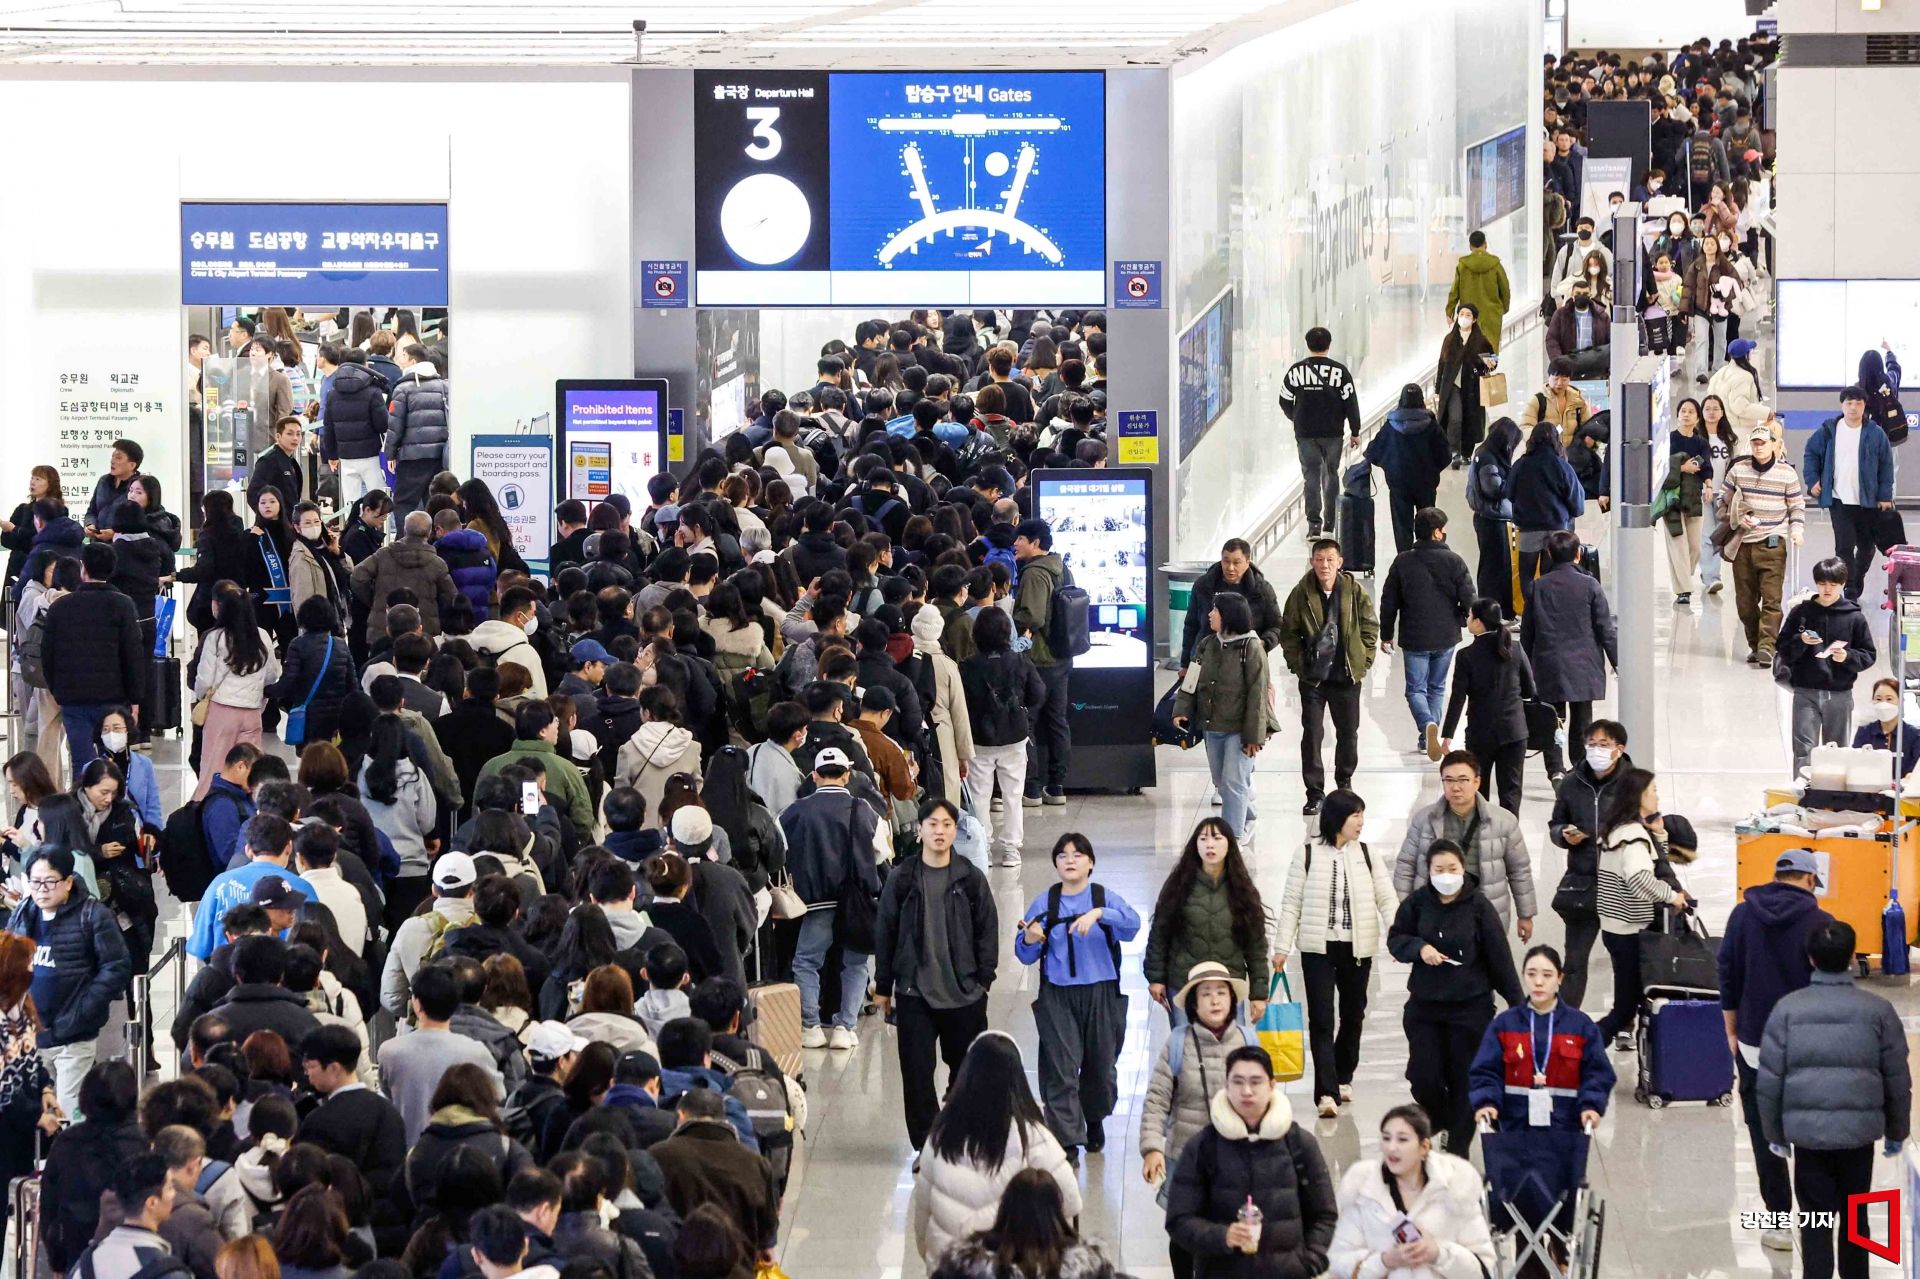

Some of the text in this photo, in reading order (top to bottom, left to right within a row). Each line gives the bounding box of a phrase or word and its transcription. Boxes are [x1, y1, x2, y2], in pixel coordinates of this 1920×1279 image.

[713, 84, 750, 100] 출국장
[755, 87, 814, 99] Departure Hall
[905, 84, 983, 103] 탑승구 안내
[988, 87, 1032, 102] Gates
[744, 107, 782, 160] 3
[190, 231, 439, 250] 승무원 도심공항 교통약자우대출구
[1311, 183, 1374, 313] Departures
[59, 373, 89, 384] 승무원
[110, 373, 139, 384] 외교관
[59, 401, 163, 413] 도심공항터미널 이용객
[572, 404, 653, 415] Prohibited Items
[60, 429, 123, 440] 보행상 장애인
[477, 451, 504, 459] Please
[60, 457, 90, 468] 고령자
[494, 461, 531, 469] passport
[482, 470, 518, 478] boarding
